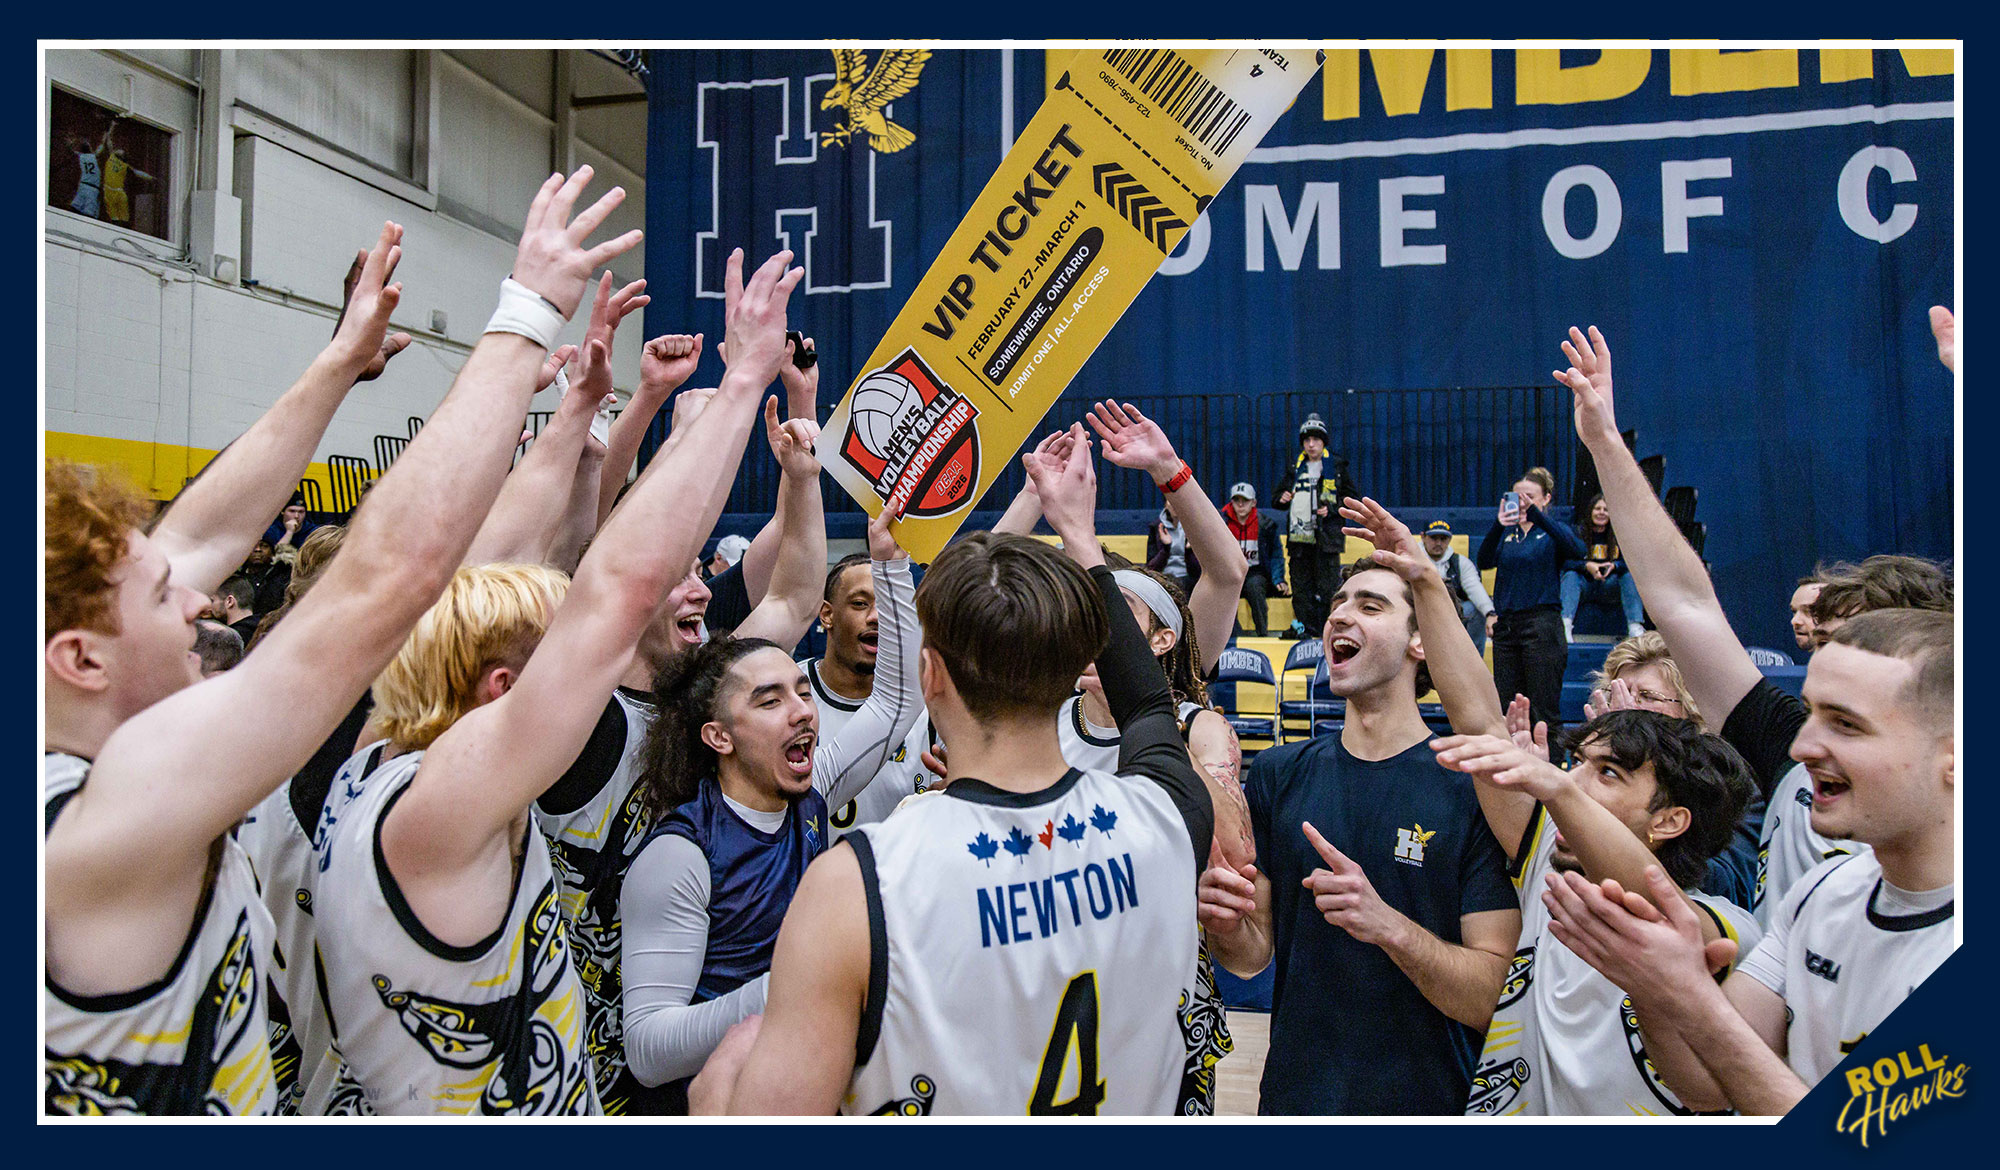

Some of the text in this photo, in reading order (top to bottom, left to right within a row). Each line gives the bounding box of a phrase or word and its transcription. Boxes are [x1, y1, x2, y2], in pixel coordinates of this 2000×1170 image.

[1098, 70, 1152, 119] 123-456-7890
[1249, 64, 1264, 78] 4
[1174, 135, 1214, 171] No. Ticket
[921, 123, 1085, 341] VIP TICKET
[1541, 157, 1733, 260] OF
[1046, 245, 1090, 302] ONTARIO
[967, 286, 1022, 360] FEBRUARY
[1008, 265, 1110, 399] ADMIT ONE ALL-ACCESS
[876, 392, 957, 495] VOLLEYBALL
[882, 404, 923, 455] MEN'S
[934, 459, 964, 497] OCAA
[947, 474, 968, 500] 2026
[977, 852, 1139, 948] NEWTON
[1026, 968, 1107, 1116] 4
